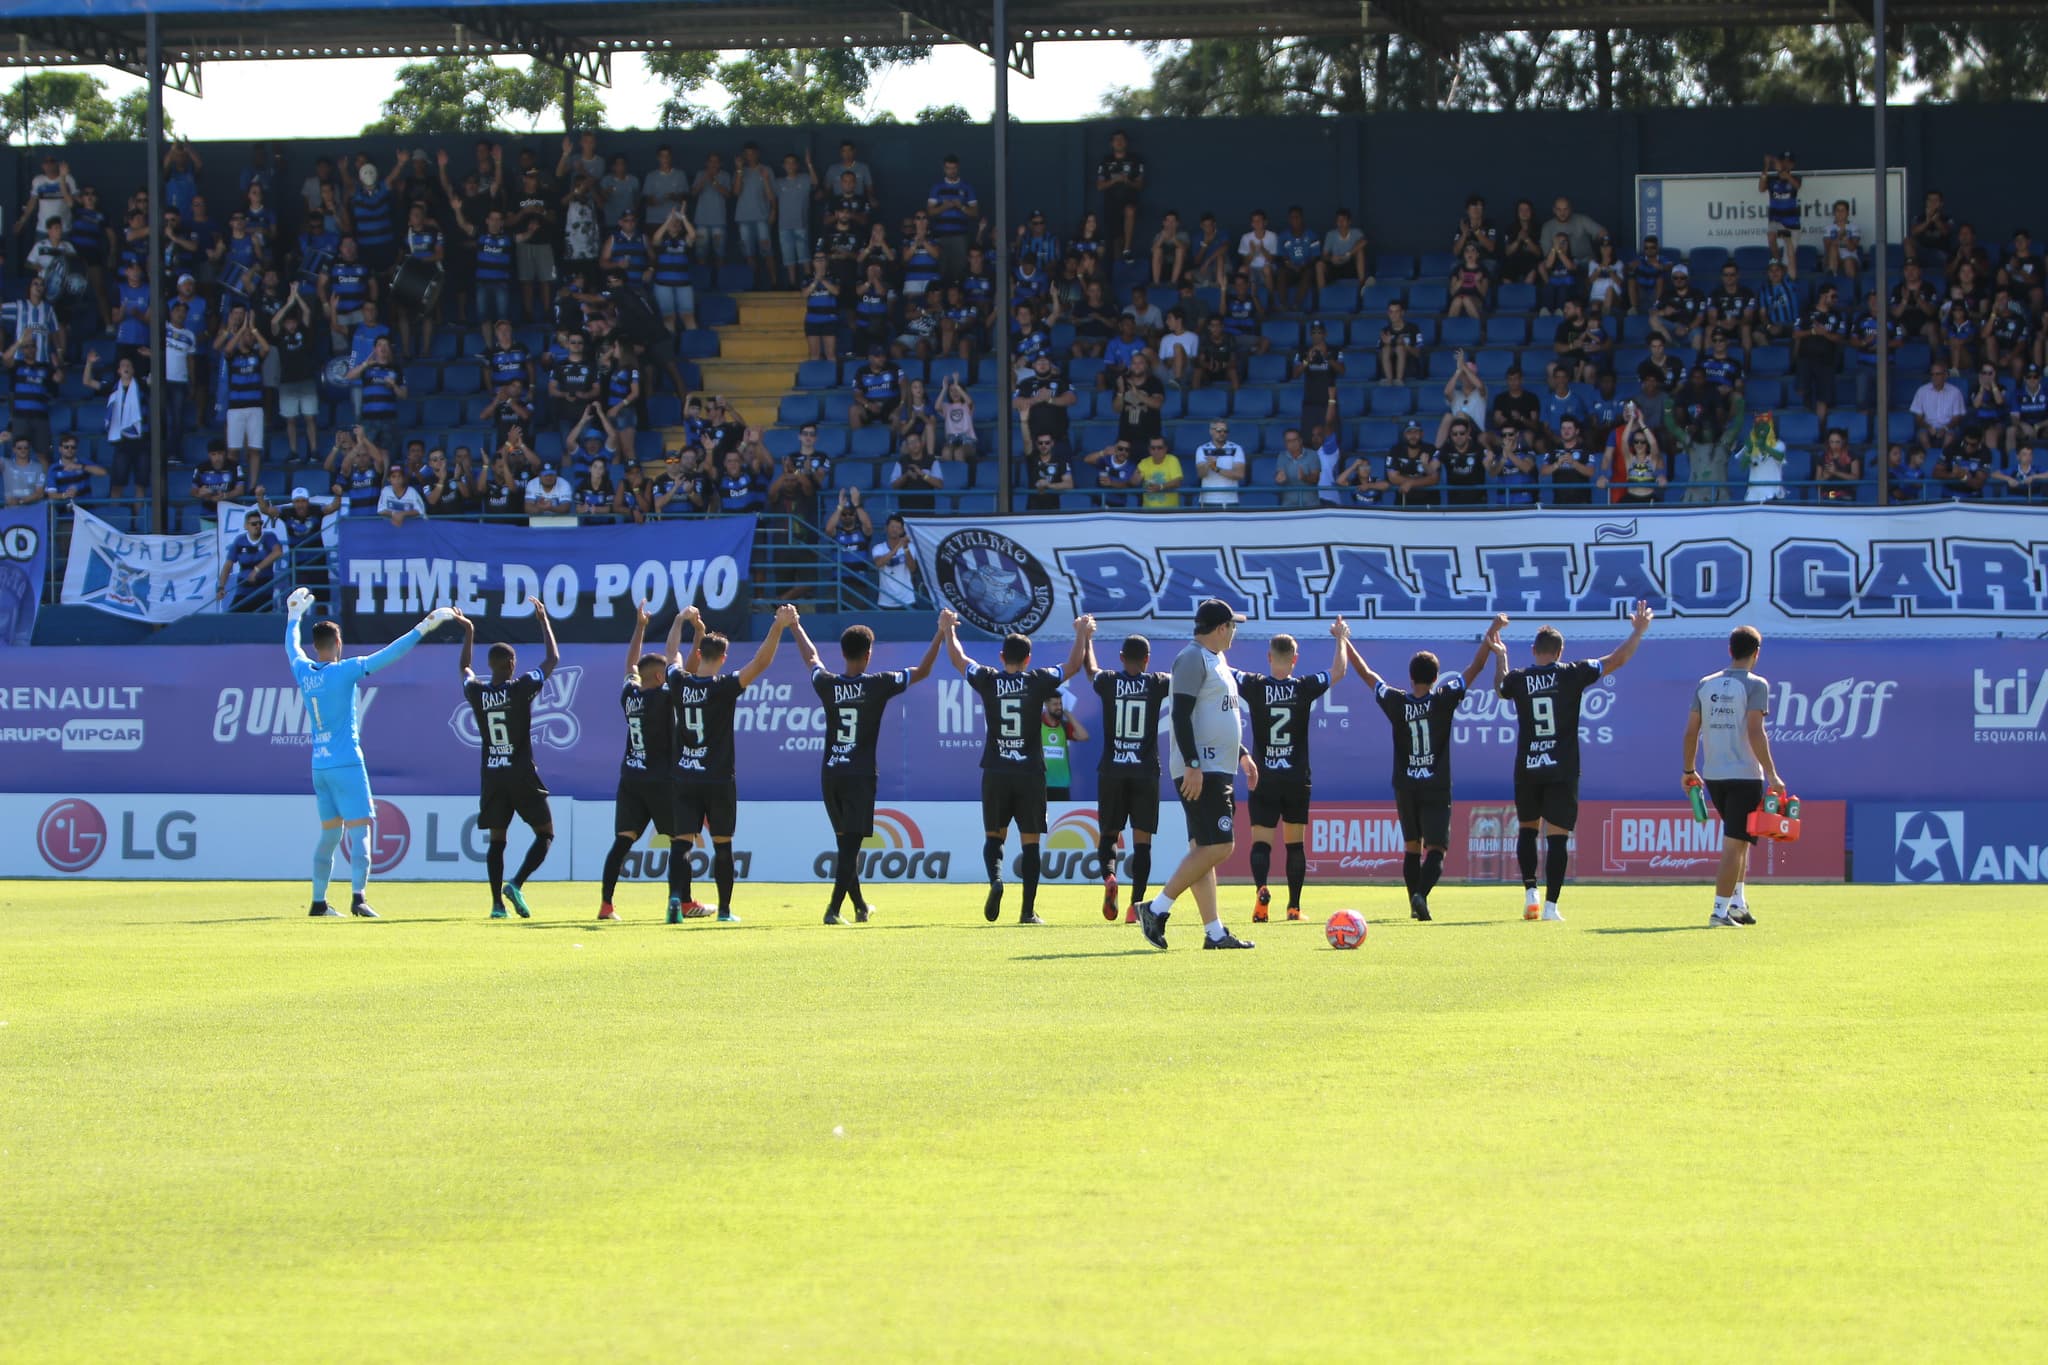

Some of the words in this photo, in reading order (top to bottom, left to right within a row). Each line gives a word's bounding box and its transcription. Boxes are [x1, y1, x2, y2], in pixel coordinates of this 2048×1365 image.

[1053, 519, 1753, 620] BATALHÃO
[1769, 536, 2048, 620] GAR
[349, 557, 488, 617] TIME
[501, 562, 579, 620] DO
[593, 554, 739, 618] POVO
[682, 686, 708, 704] BALY
[737, 678, 793, 701] nha
[834, 683, 863, 703] BALY
[996, 678, 1025, 697] BALY
[1115, 679, 1145, 698] BALY
[1265, 685, 1295, 705] BALY
[1525, 673, 1556, 695] BALY
[311, 696, 323, 731] 1
[481, 689, 508, 711] BALY
[937, 679, 984, 734] KI-
[487, 711, 509, 746] 6
[684, 707, 704, 744] 4
[837, 708, 858, 743] 3
[1001, 699, 1022, 737] 5
[1115, 699, 1147, 739] 10
[1270, 707, 1291, 745] 2
[1532, 696, 1556, 737] 9
[0, 727, 61, 742] RUPO
[65, 728, 141, 741] VIPCAR
[938, 739, 983, 748] TEMPLO
[1408, 719, 1431, 755] 11
[1453, 726, 1614, 744] UTDRS
[1765, 725, 1841, 744] ercados
[1203, 747, 1216, 760] 15
[121, 809, 197, 860] LG
[1311, 818, 1406, 853] BRAHM
[619, 850, 753, 880] auoa
[812, 850, 951, 880] arora
